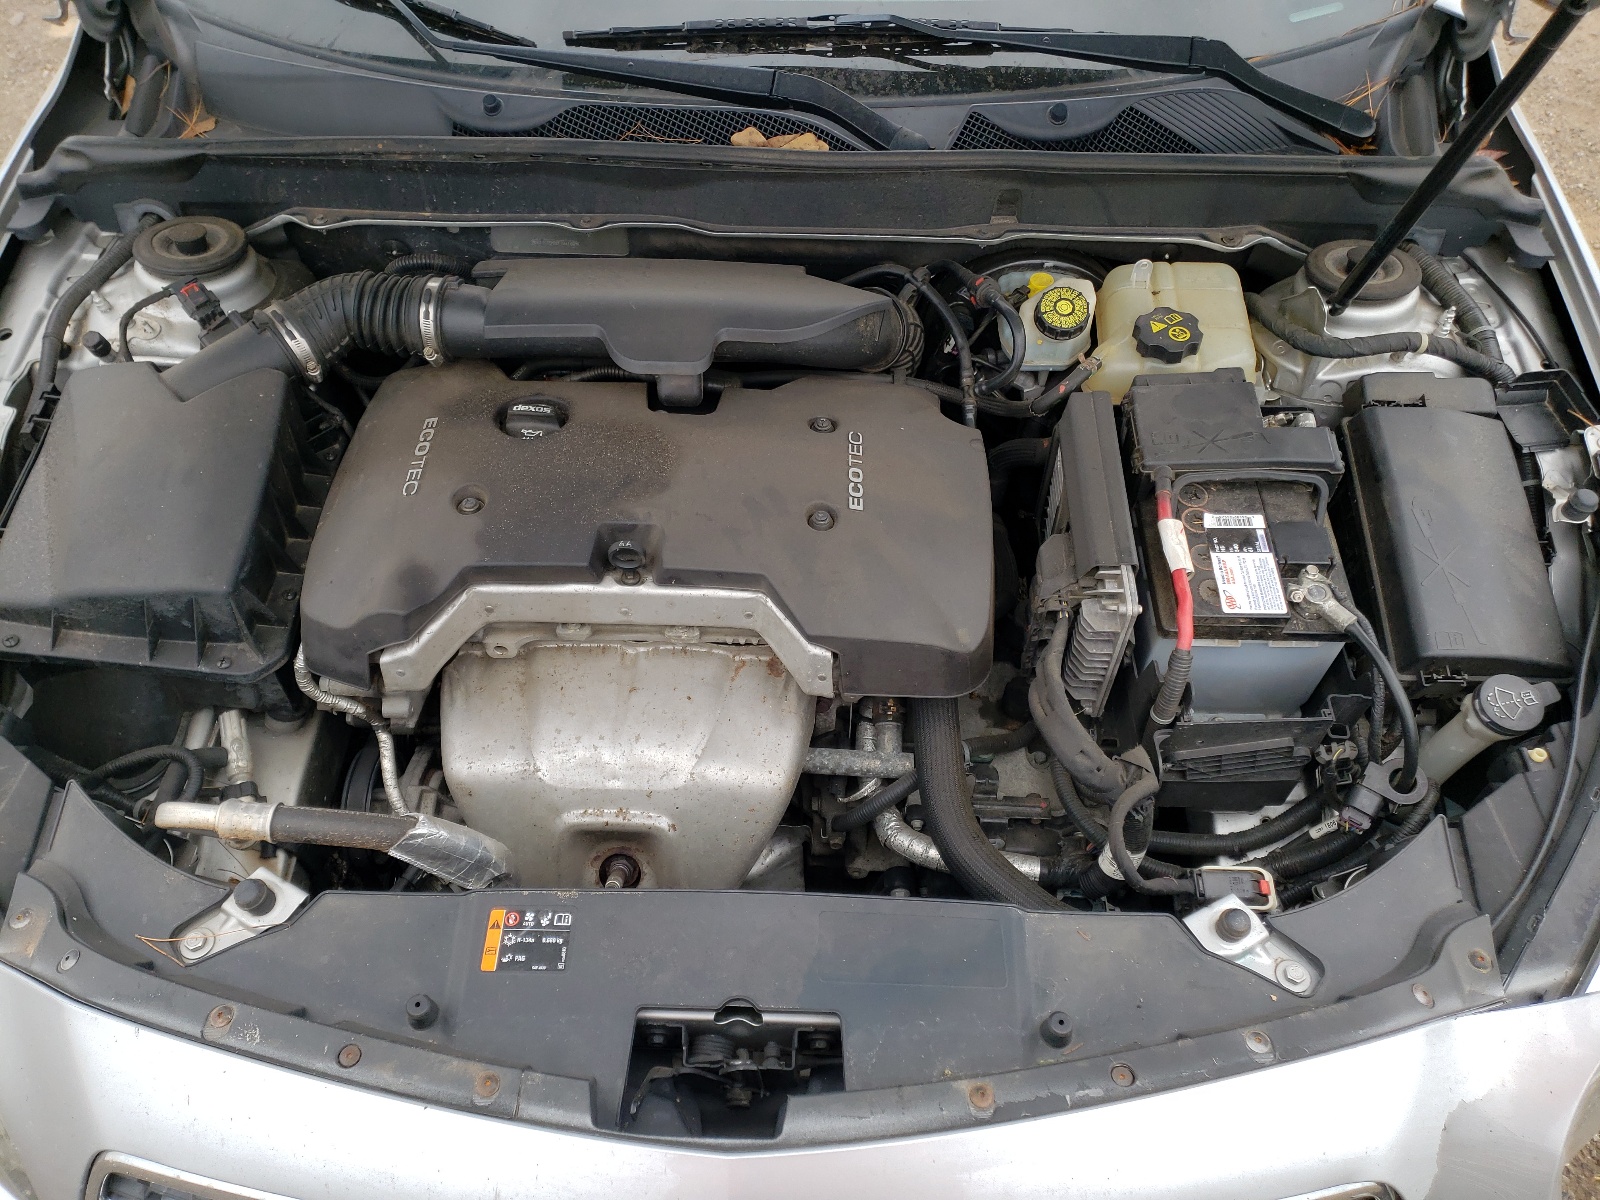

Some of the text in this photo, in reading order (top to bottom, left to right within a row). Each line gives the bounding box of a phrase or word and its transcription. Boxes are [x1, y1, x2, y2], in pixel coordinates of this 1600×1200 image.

[512, 404, 551, 414] dexos
[402, 417, 439, 496] ECOTEC
[848, 431, 864, 511] ECOTEC
